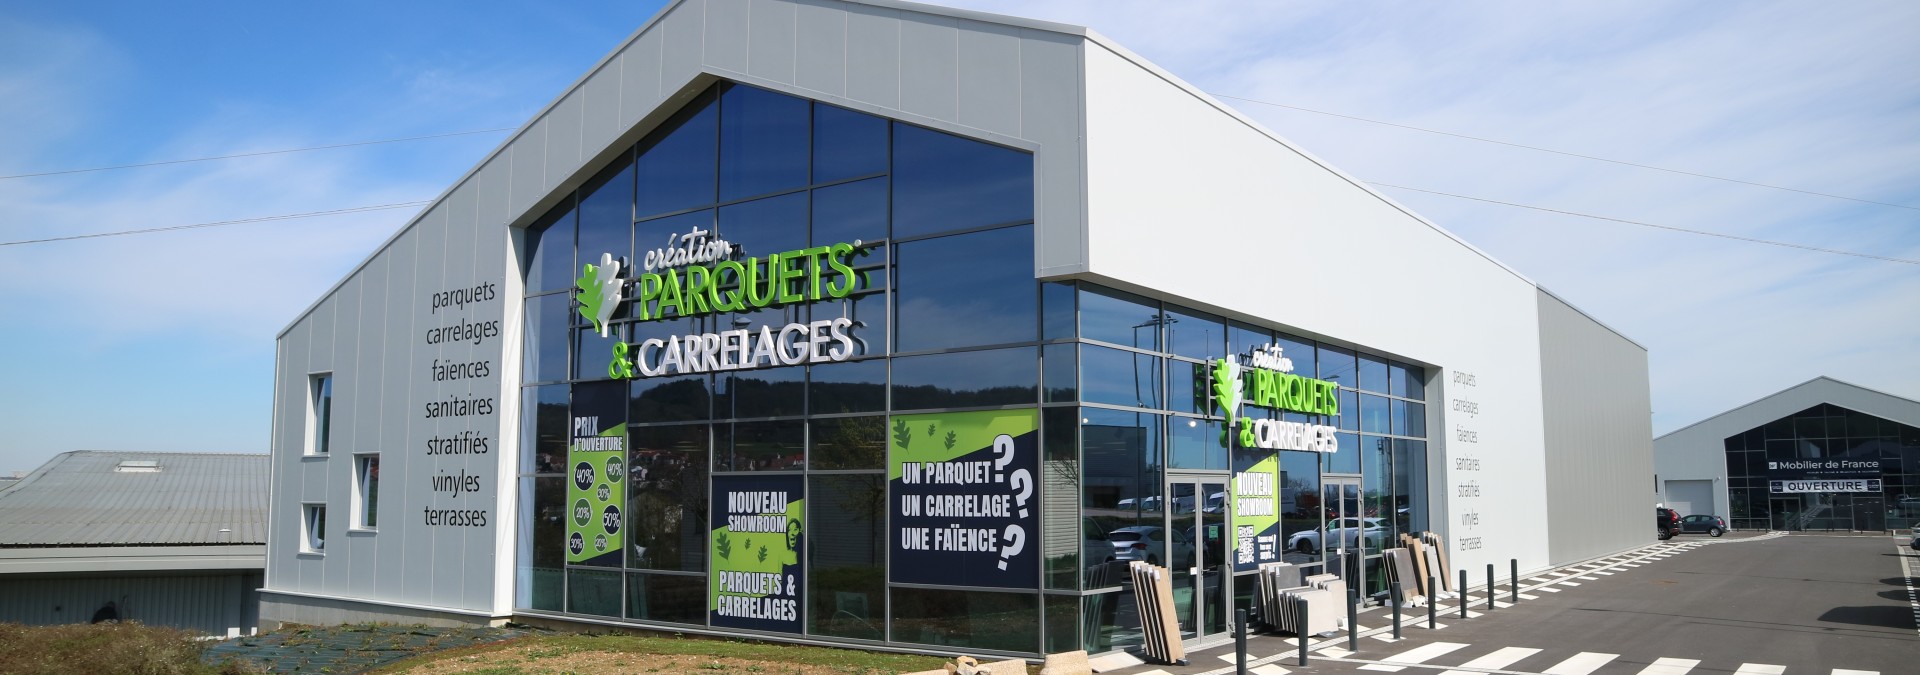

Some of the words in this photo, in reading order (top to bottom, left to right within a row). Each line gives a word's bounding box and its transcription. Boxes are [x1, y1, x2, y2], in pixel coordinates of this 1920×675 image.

[643, 225, 732, 272] création
[639, 242, 856, 321] PARQUETS
[432, 281, 495, 314] parquets
[426, 318, 499, 345] carrelages
[608, 342, 635, 380] &
[637, 317, 854, 377] CARRELAGES
[432, 359, 490, 382] faïences
[1453, 370, 1476, 389] parquets
[1254, 368, 1337, 416] PARQUETS
[425, 393, 493, 418] sanitaires
[1453, 395, 1479, 418] carrelages
[574, 416, 599, 437] PRIX
[1240, 417, 1256, 447] &
[1457, 424, 1478, 444] faïences
[427, 430, 488, 456] stratifiés
[574, 436, 623, 452] D'OUVERTURE
[607, 463, 622, 477] 40%
[902, 462, 921, 484] UN
[1456, 453, 1480, 471] sanitaires
[1780, 460, 1822, 470] Mobilier
[1825, 460, 1839, 469] de
[1841, 460, 1879, 469] France
[432, 469, 480, 498] vinyles
[576, 468, 594, 484] 40%
[1237, 472, 1273, 496] NOUVEAU
[1788, 481, 1862, 491] OUVERTURE
[1458, 480, 1480, 497] stratifiés
[728, 491, 787, 514] NOUVEAU
[901, 494, 921, 517] UN
[1237, 498, 1273, 516] SHOWROOM
[424, 504, 487, 527] terrasses
[603, 512, 620, 528] 50%
[728, 515, 787, 533] SHOWROOM
[1461, 507, 1479, 530] vinyles
[901, 527, 930, 550] UNE
[1459, 535, 1482, 551] terrasses
[719, 570, 782, 595] PARQUETS
[786, 574, 796, 596] &
[717, 595, 797, 622] CARRELAGES
